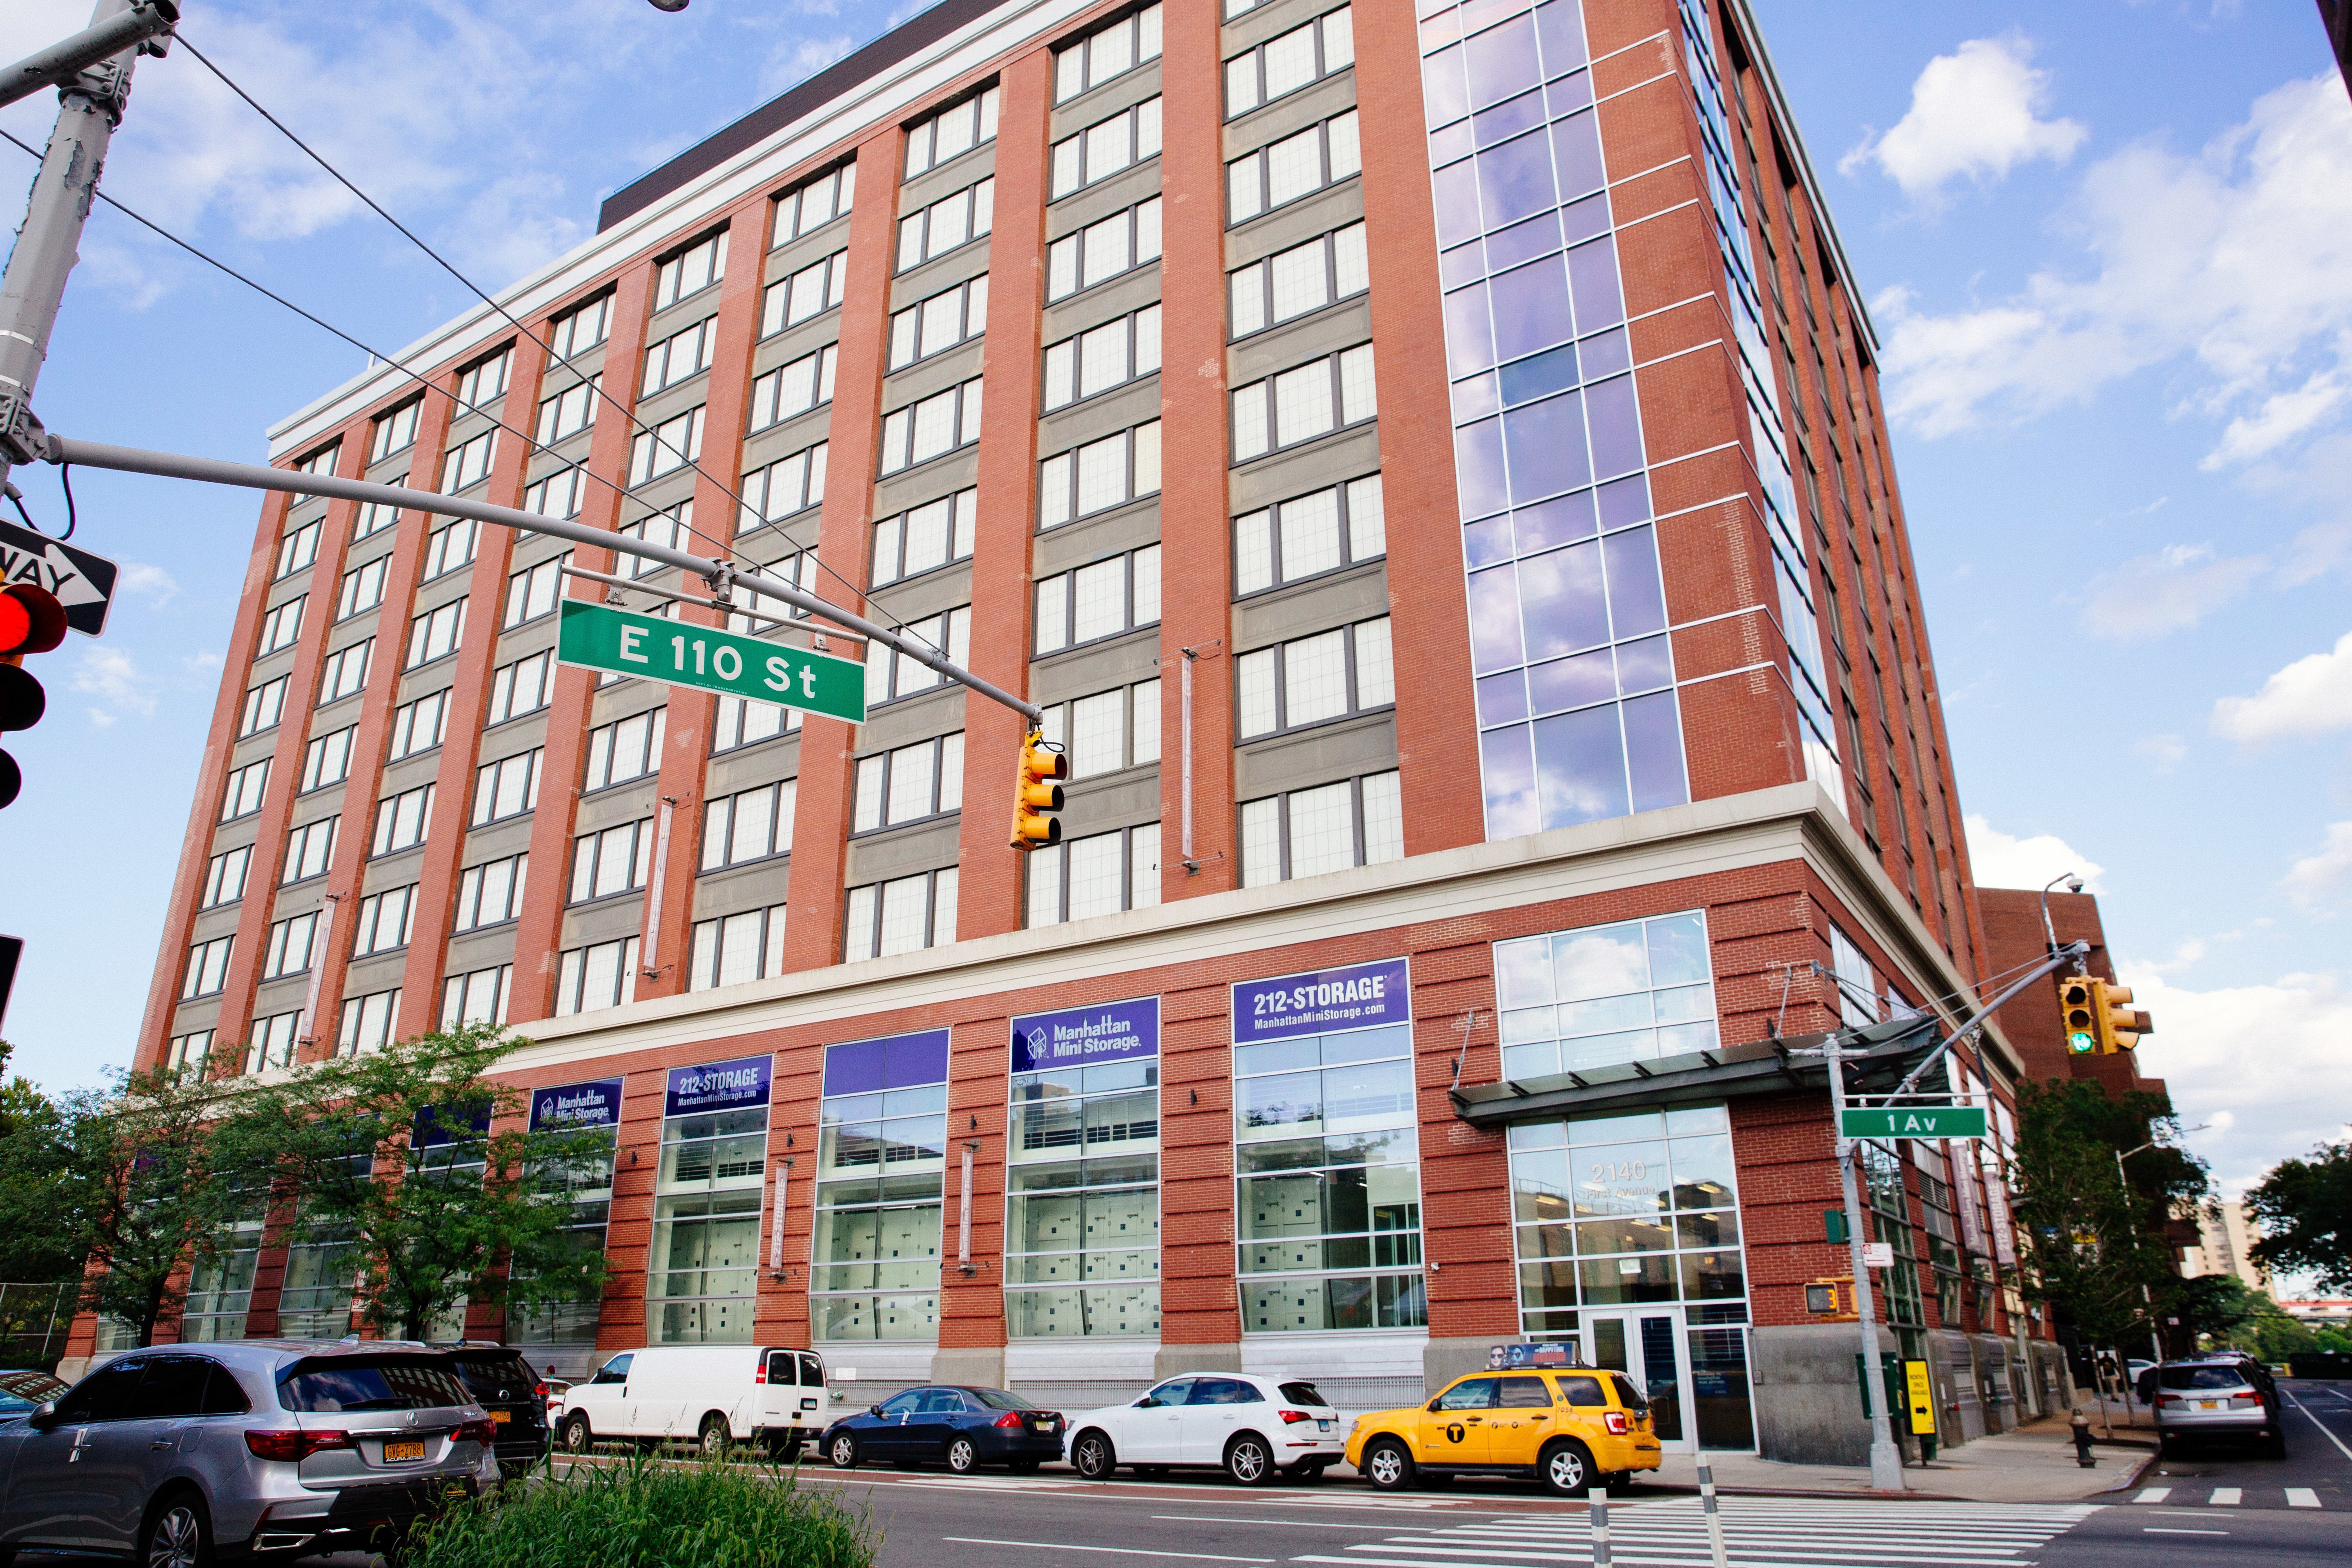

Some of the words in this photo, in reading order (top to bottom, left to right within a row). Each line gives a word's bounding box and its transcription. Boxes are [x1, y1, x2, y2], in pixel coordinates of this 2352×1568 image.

[620, 624, 649, 664] E
[671, 635, 743, 681] 110
[763, 656, 816, 699] St
[713, 685, 747, 695] TRANSPORTATION
[1254, 975, 1385, 1015] 212-STORAGE
[1254, 1004, 1385, 1029] ManhattanMiniStorage.com
[1054, 1014, 1130, 1041] Manhattan
[1054, 1040, 1082, 1057] Mini
[679, 1067, 758, 1094] 212-STORAGE
[557, 1089, 605, 1109] Manhattan
[678, 1090, 756, 1106] ManhattanMiniStorage.com
[557, 1109, 574, 1121] Mini
[1888, 1115, 1895, 1131] 1
[1904, 1114, 1936, 1131] Av
[1592, 1160, 1646, 1183] 2140
[1586, 1189, 1611, 1199] First
[1615, 1186, 1655, 1197] Avenue
[1450, 1426, 1461, 1441] T
